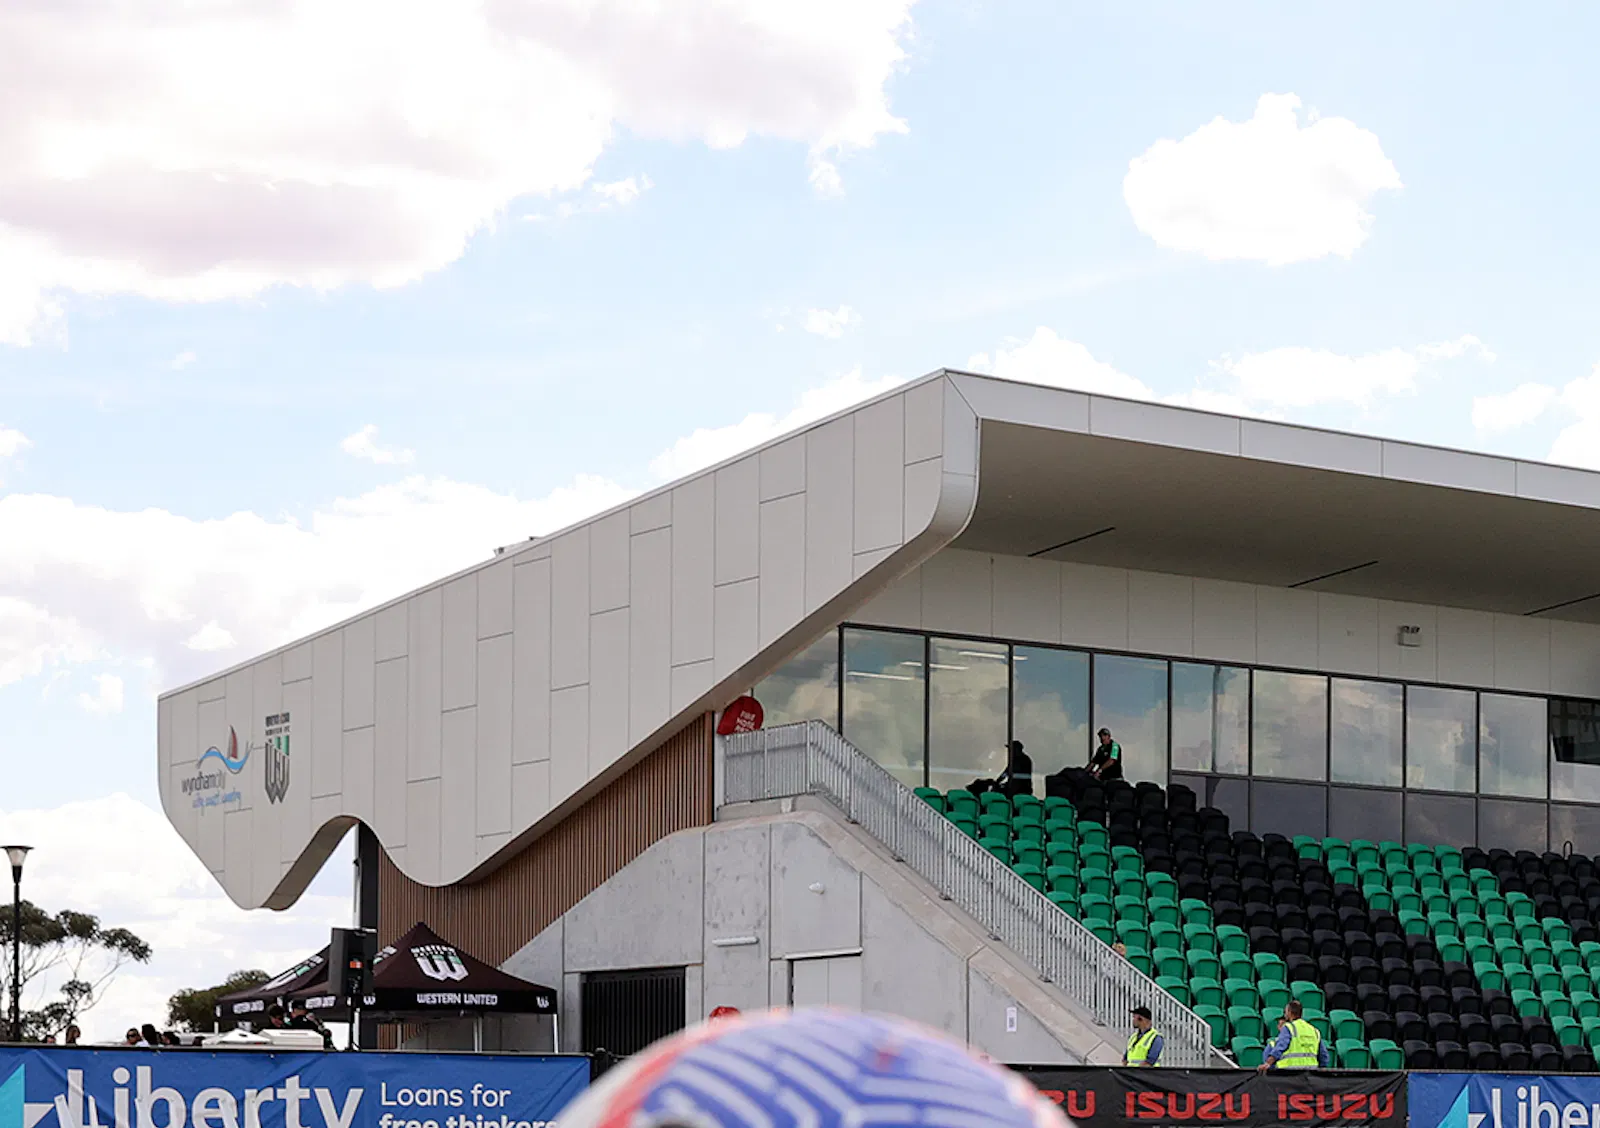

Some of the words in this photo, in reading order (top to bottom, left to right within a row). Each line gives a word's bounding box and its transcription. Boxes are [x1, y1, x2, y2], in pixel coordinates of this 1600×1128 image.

[416, 993, 462, 1004] WESTERN
[463, 993, 498, 1005] UNITED
[379, 1081, 463, 1108] Loans
[470, 1083, 512, 1108] for
[1125, 1092, 1251, 1120] ISUZU
[1277, 1092, 1395, 1121] ISUZU
